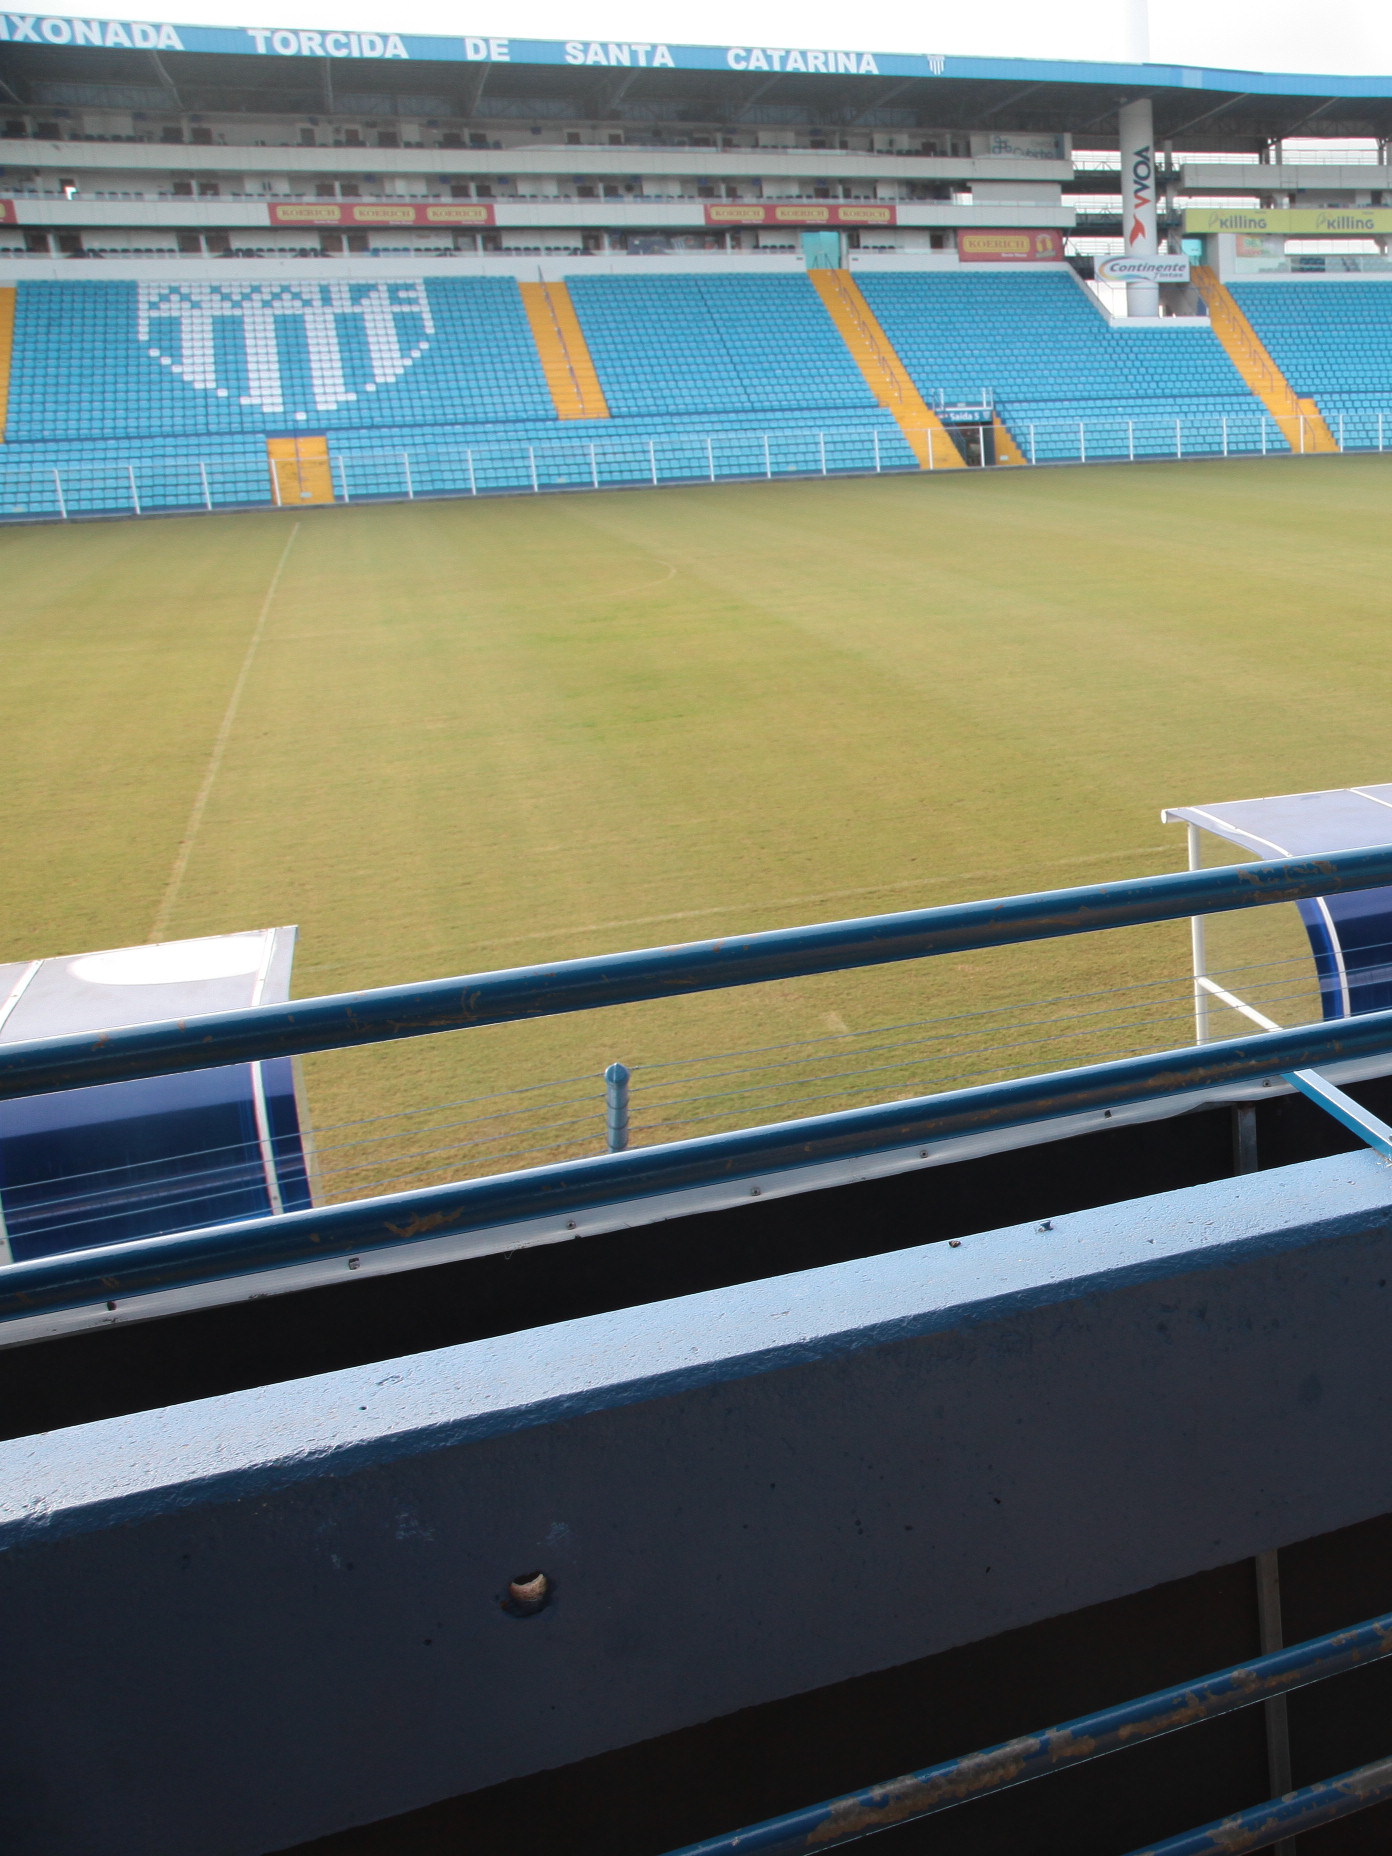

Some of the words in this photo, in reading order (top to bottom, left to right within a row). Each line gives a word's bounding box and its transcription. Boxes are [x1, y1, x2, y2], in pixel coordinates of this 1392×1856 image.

[247, 28, 409, 59] TORCIDA
[464, 37, 511, 61] DE
[565, 42, 675, 67] SANTA
[727, 48, 879, 75] CATARINA
[1110, 262, 1186, 272] Continente
